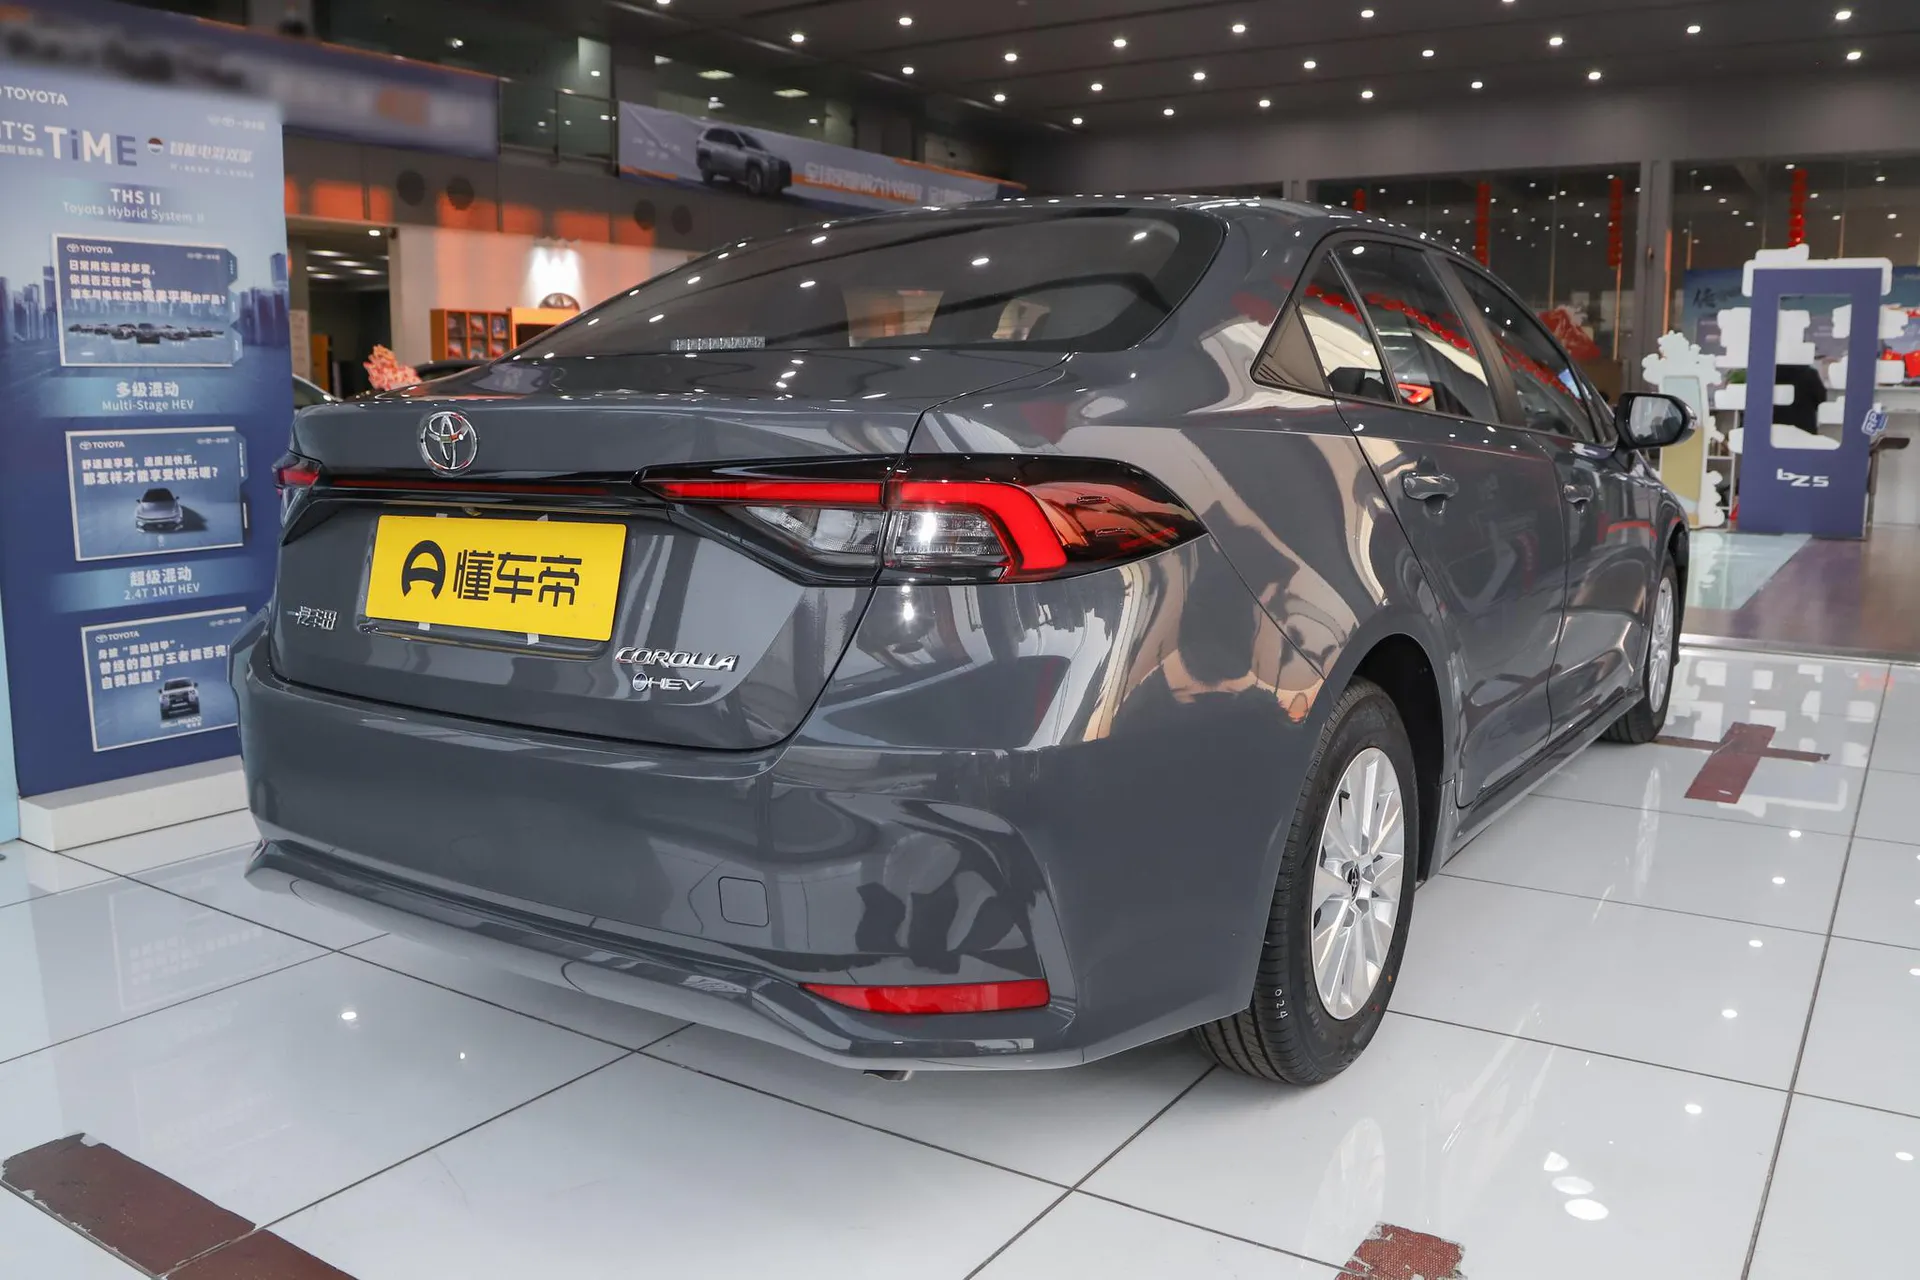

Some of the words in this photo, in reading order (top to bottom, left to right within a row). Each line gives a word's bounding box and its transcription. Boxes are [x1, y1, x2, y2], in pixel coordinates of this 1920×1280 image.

[4, 86, 68, 106] TOYOTA
[110, 188, 145, 205] THS
[150, 192, 161, 206] II
[63, 202, 104, 217] Toyota
[107, 204, 147, 219] Hybrid
[151, 209, 192, 222] System
[80, 244, 113, 254] TOYOTA
[116, 381, 180, 398] 多级混动
[102, 399, 169, 413] Multi-Stage
[172, 399, 194, 410] HEV
[92, 441, 125, 450] TOYOTA
[130, 566, 192, 587] 超级混动
[453, 548, 583, 607] 懂车帝
[124, 588, 149, 600] 2.4T
[152, 585, 175, 597] 1MT
[178, 582, 200, 594] HEV
[108, 630, 140, 641] TOYOTA
[615, 646, 739, 672] COROLLA
